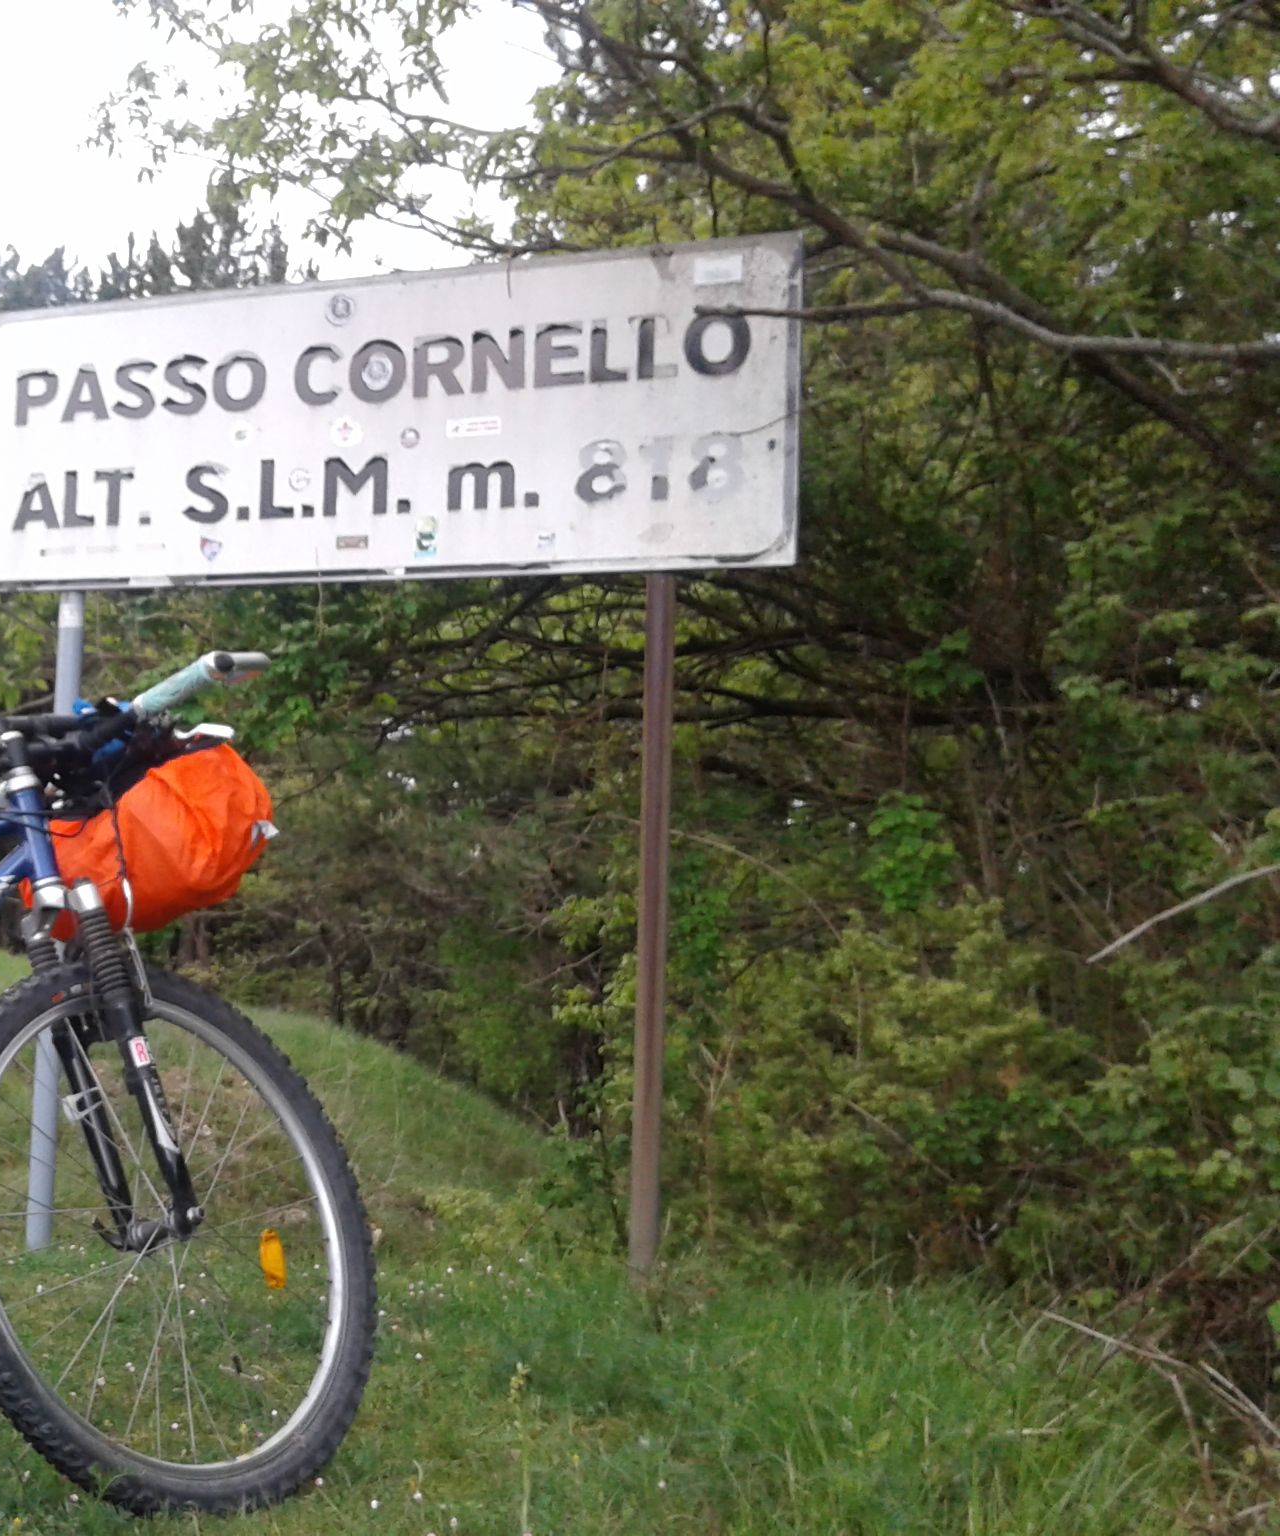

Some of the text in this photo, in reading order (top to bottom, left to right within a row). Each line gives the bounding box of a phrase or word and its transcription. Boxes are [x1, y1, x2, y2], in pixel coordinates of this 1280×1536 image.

[14, 312, 752, 427] PASSO CORNELLO
[12, 468, 152, 531] ALT.
[182, 456, 412, 524] S.L.M.
[447, 460, 540, 512] m.
